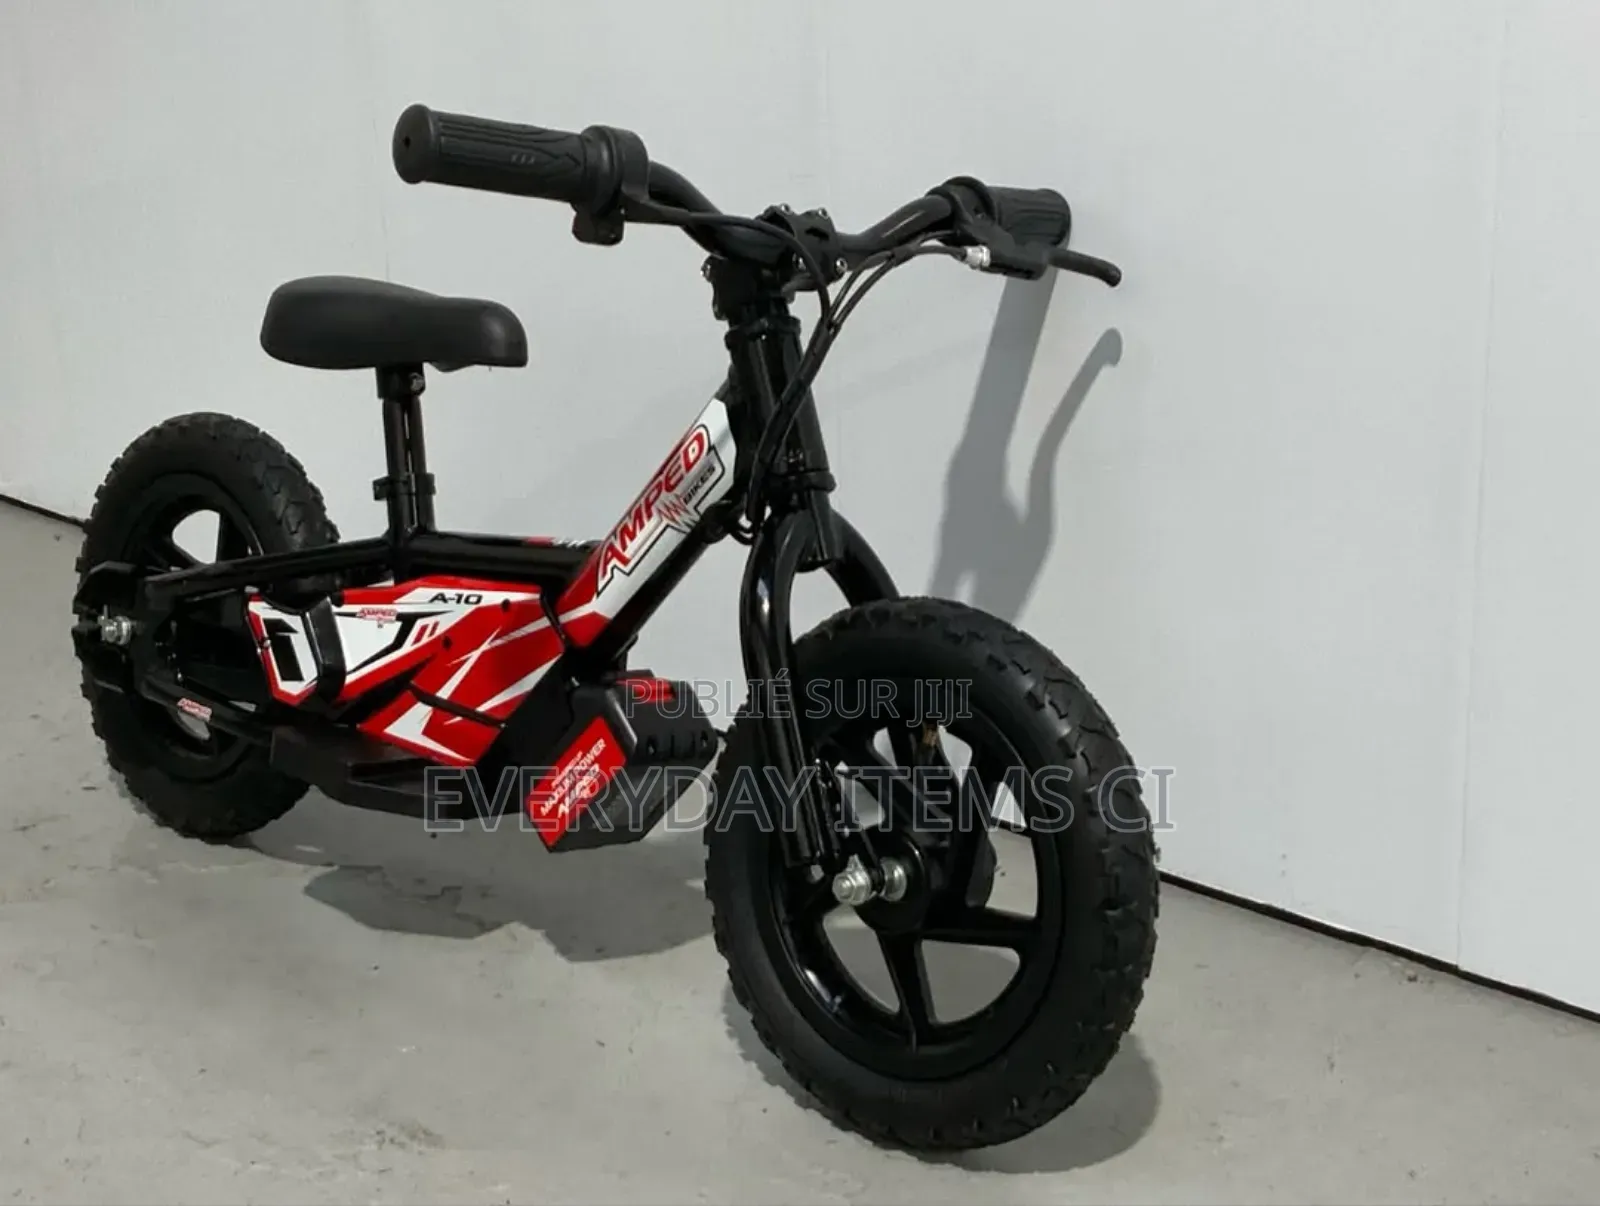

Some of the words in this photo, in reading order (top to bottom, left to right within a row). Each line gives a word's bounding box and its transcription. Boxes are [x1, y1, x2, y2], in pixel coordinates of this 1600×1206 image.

[683, 464, 717, 506] BIKES
[599, 430, 706, 579] AMPED
[357, 607, 398, 619] AMPED
[428, 592, 484, 606] A-10
